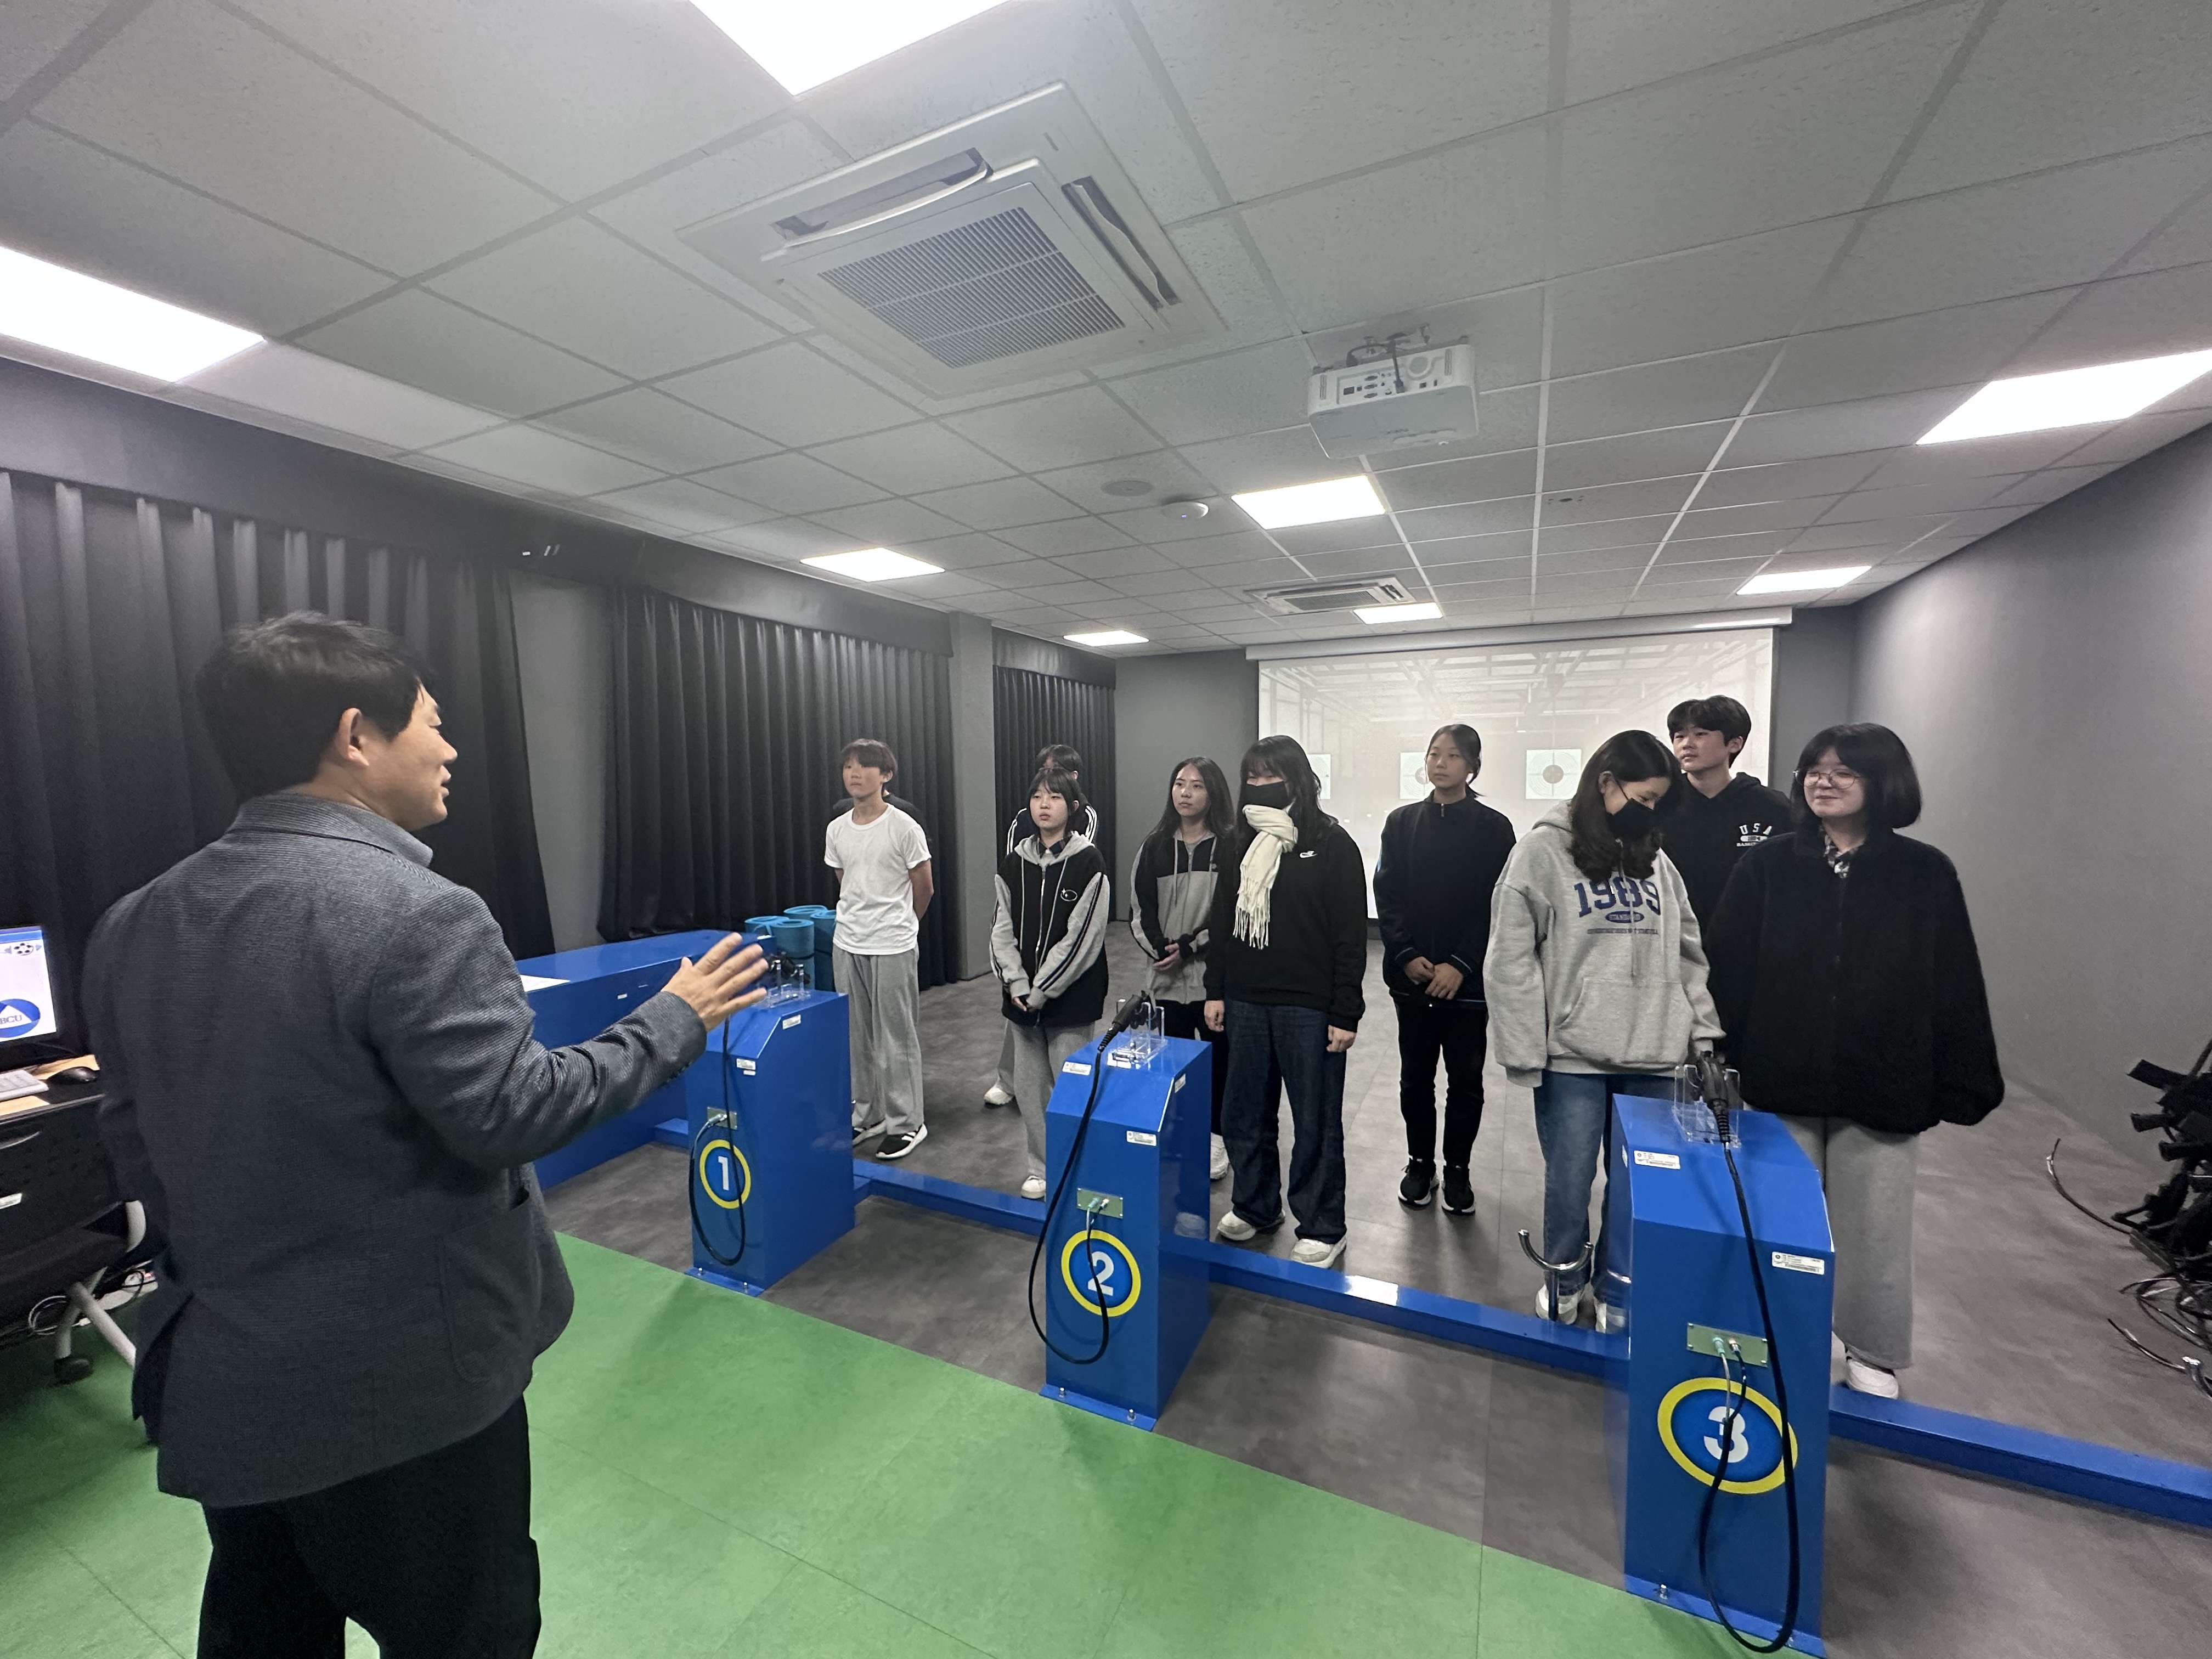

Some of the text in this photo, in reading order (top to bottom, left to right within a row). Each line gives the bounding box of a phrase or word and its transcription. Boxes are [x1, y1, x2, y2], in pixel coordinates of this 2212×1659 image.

[1574, 877, 1661, 918] 1989
[718, 1156, 729, 1190] 1
[1088, 1251, 1114, 1296] 2
[1703, 1406, 1748, 1463] 3
